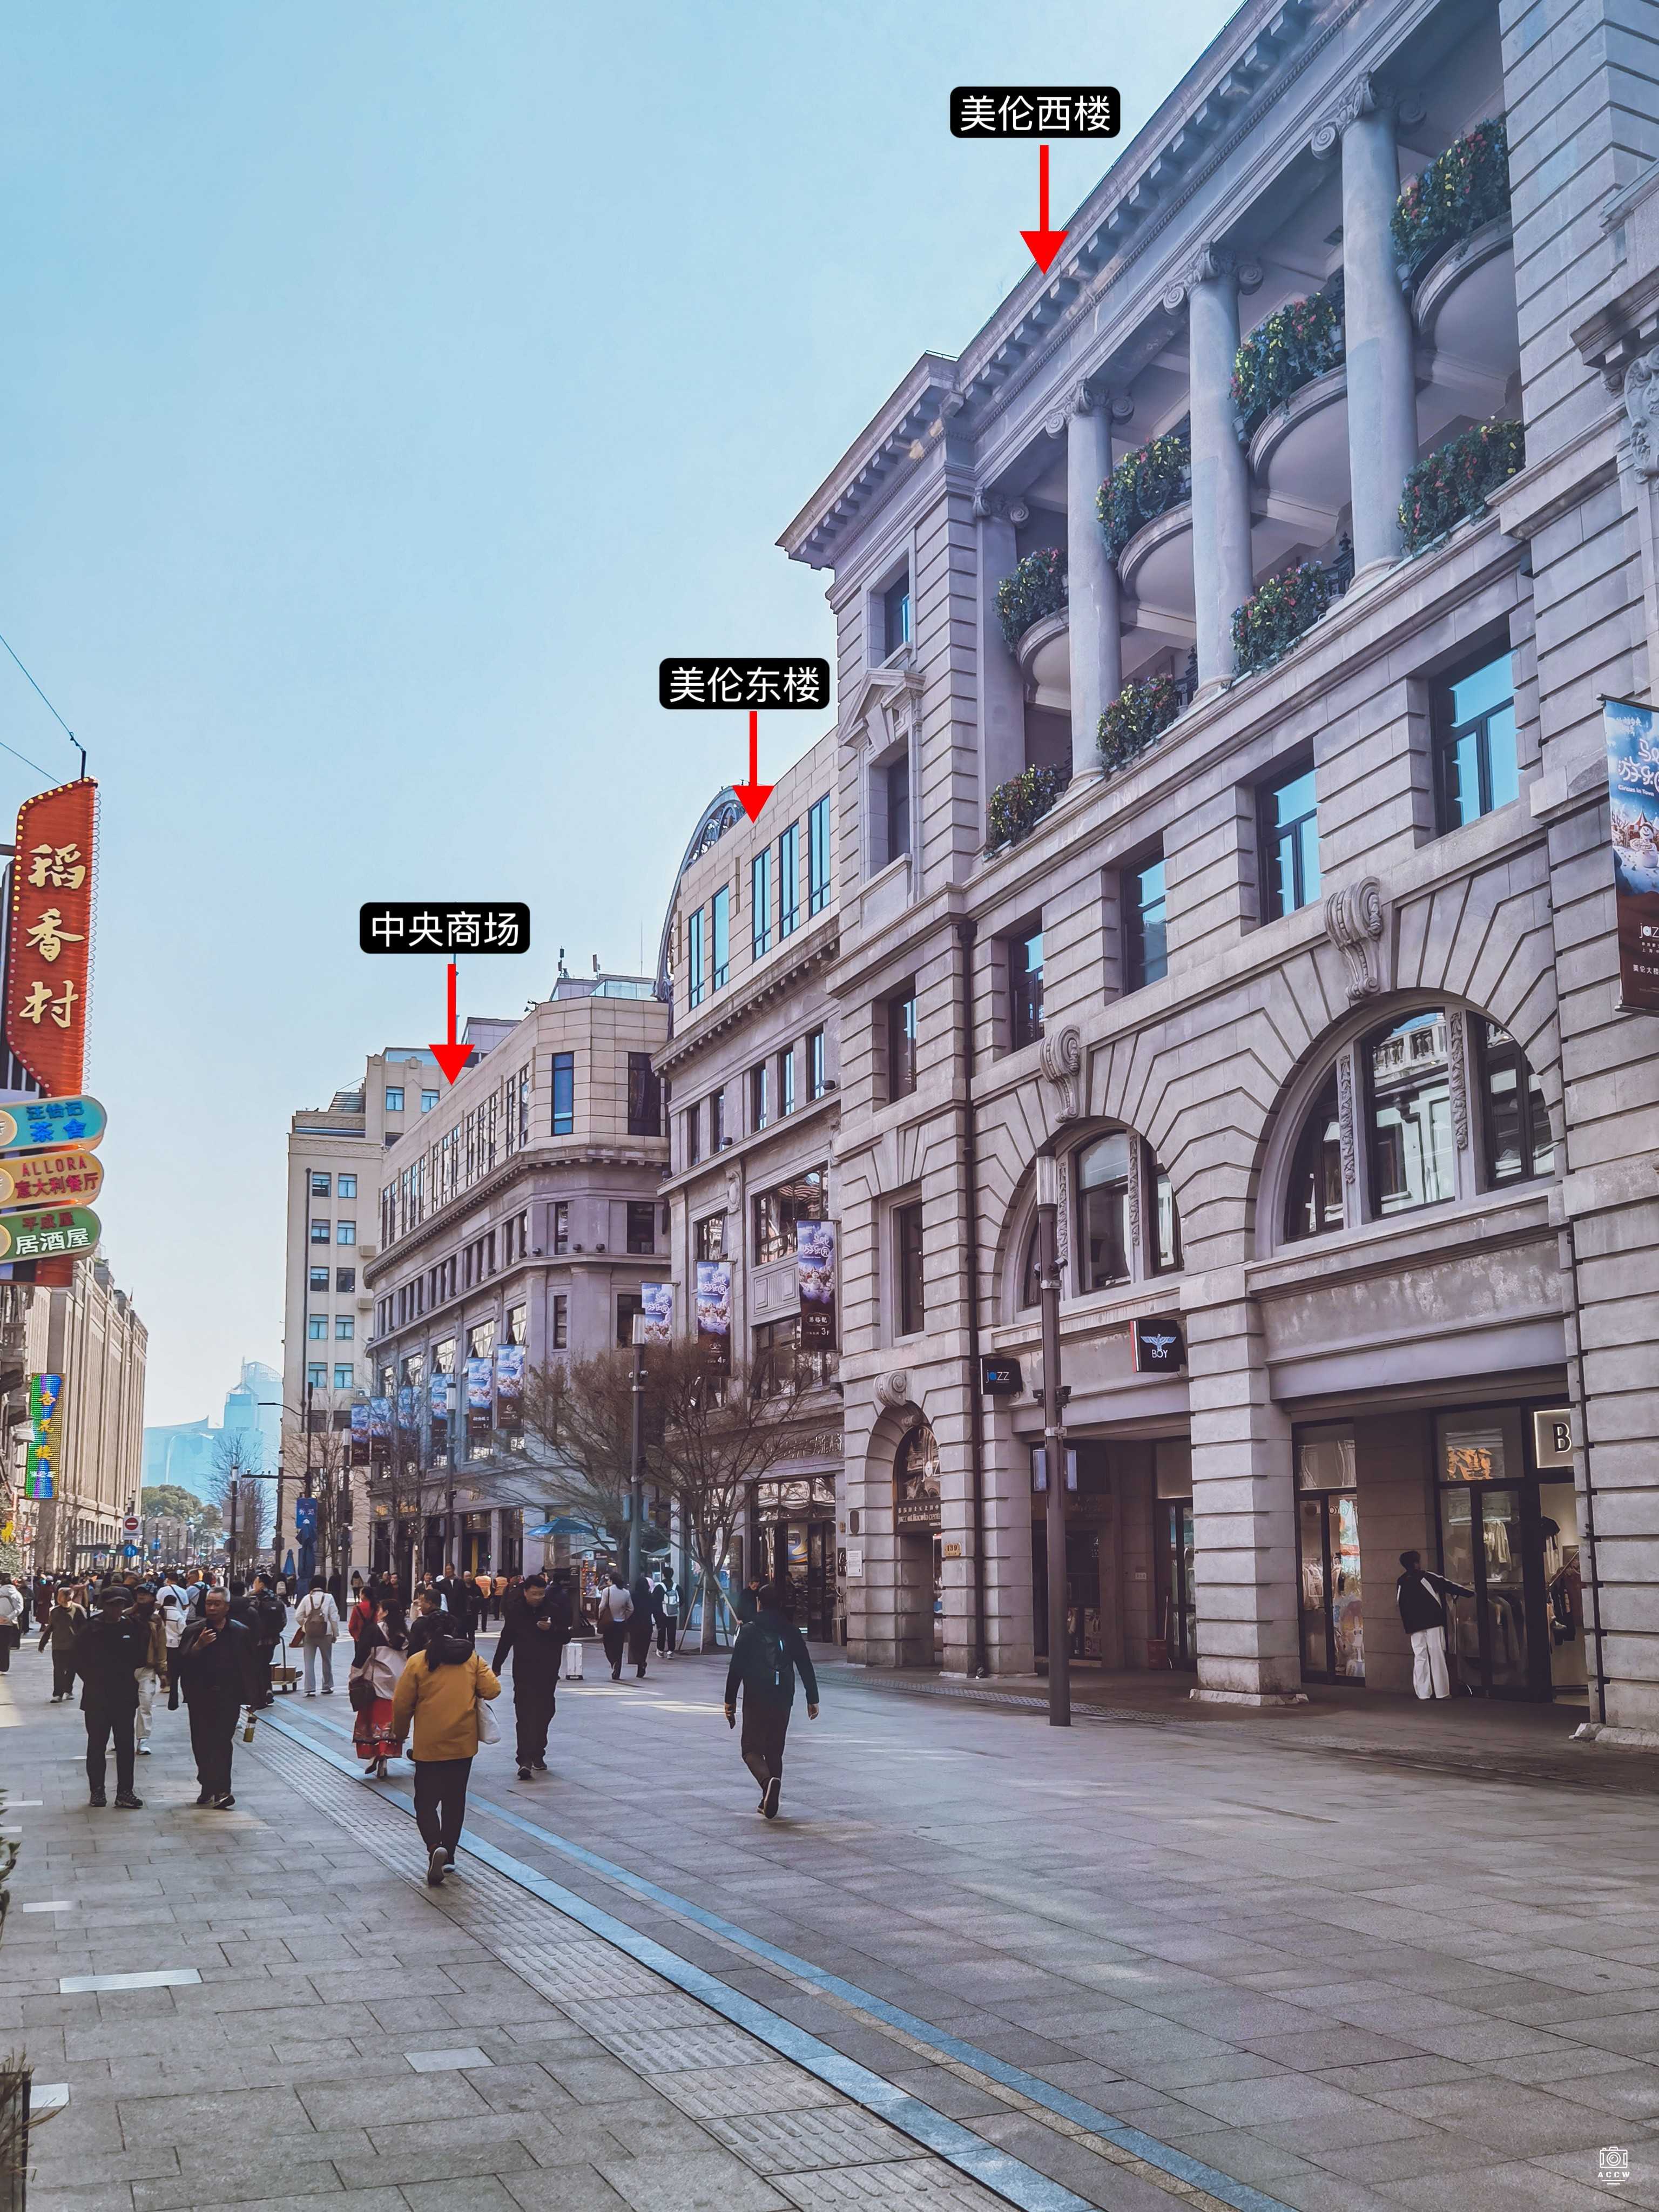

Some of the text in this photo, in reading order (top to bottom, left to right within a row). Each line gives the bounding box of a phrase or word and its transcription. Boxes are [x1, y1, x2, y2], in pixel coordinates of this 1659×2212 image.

[1618, 756, 1659, 792] 游乐
[19, 844, 86, 1028] 稻香村
[22, 1156, 88, 1178] ALLORA
[15, 1172, 99, 1199] 意大利餐厅
[16, 1227, 91, 1256] 居酒屋
[821, 1327, 830, 1336] 3F
[1152, 1349, 1168, 1358] BOY
[986, 1370, 1010, 1383] jazz
[1553, 1422, 1572, 1453] B
[921, 1458, 943, 1482] jaz
